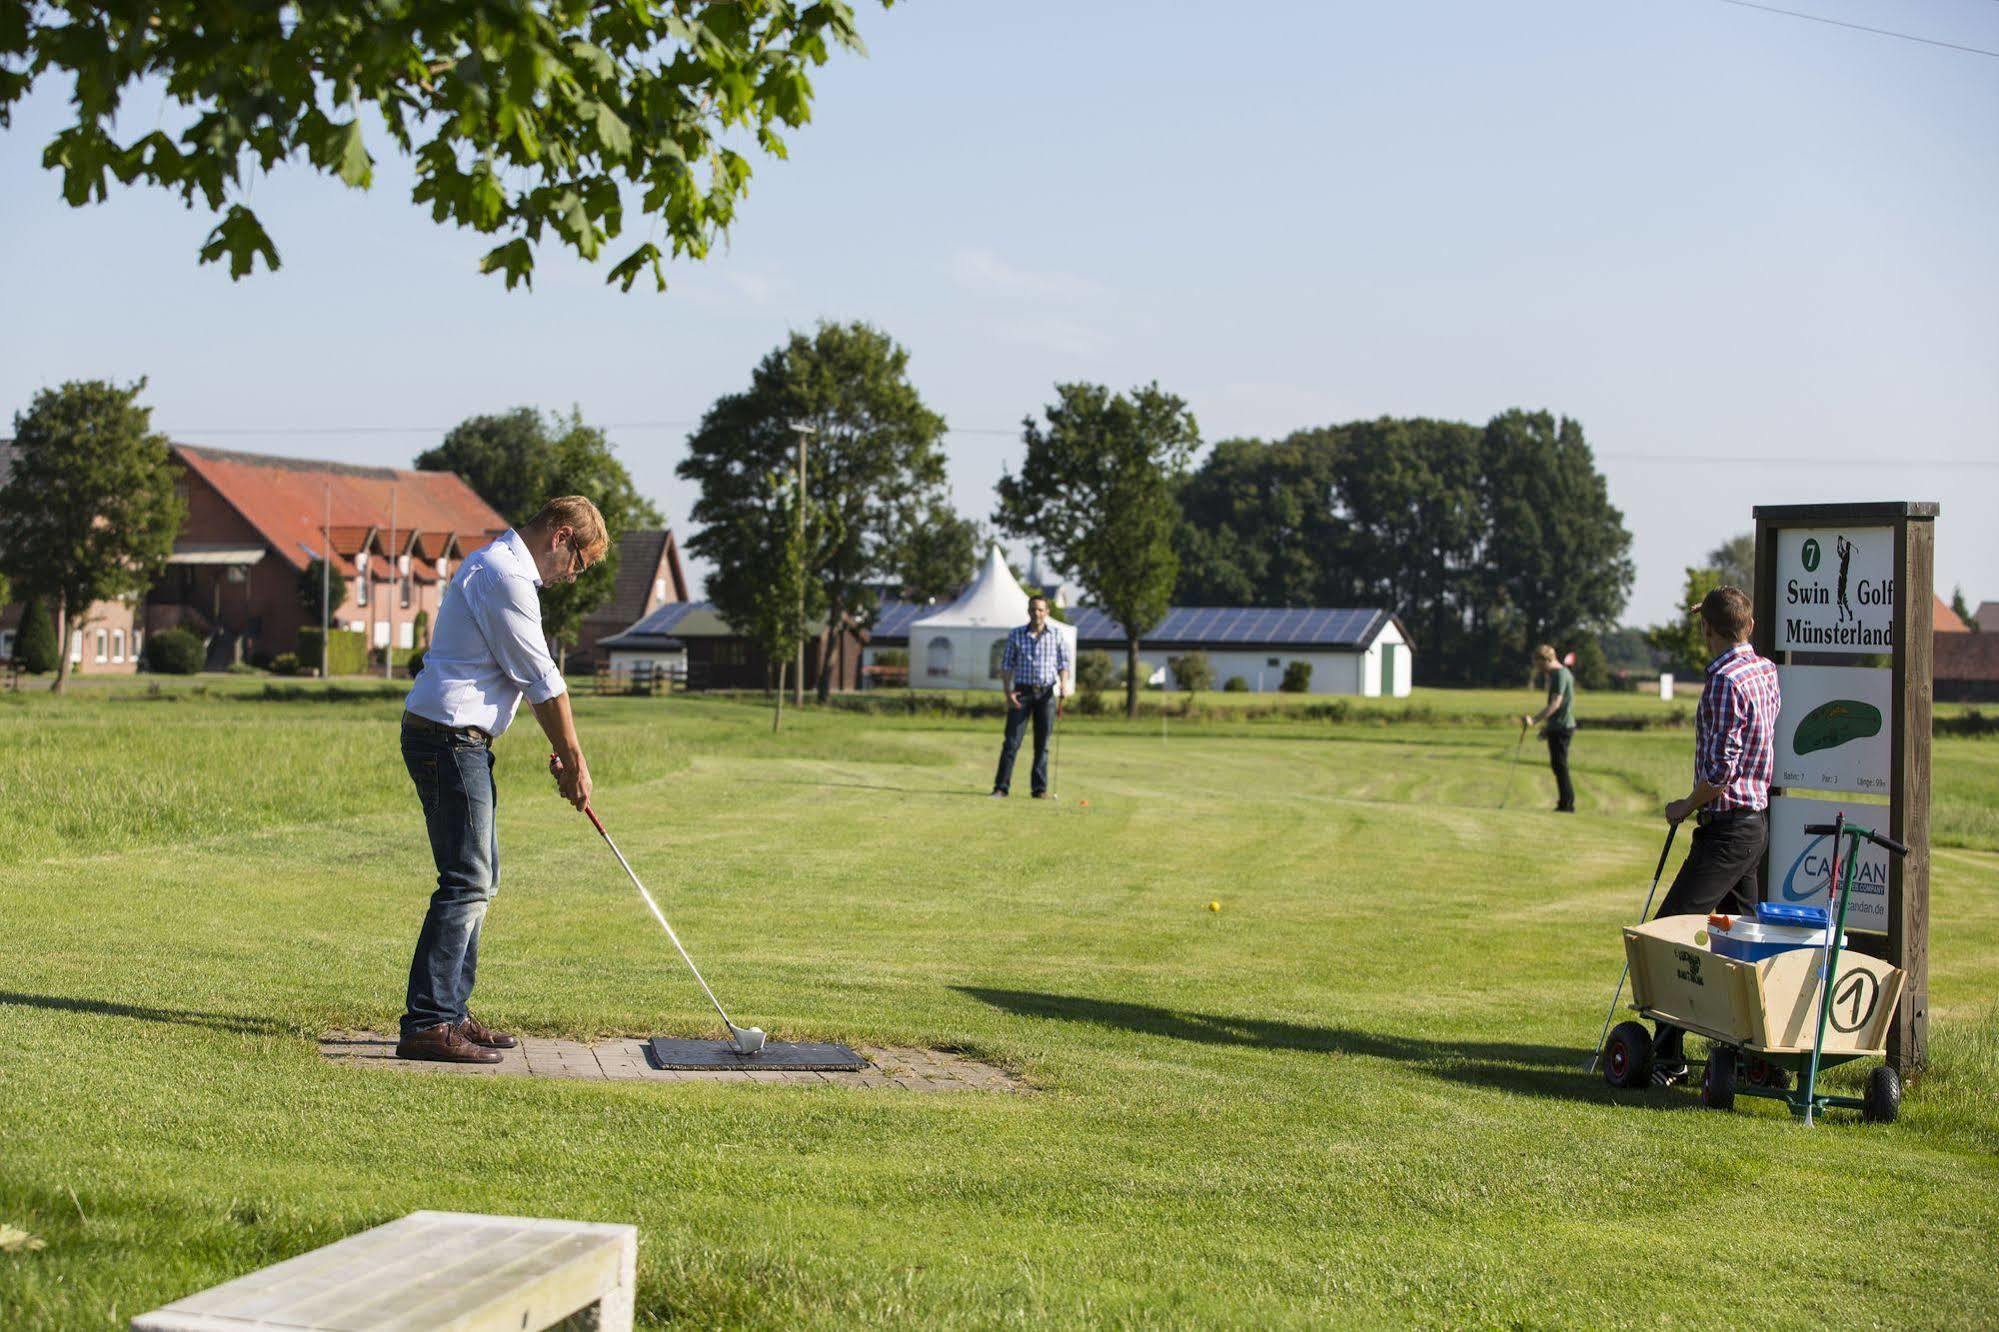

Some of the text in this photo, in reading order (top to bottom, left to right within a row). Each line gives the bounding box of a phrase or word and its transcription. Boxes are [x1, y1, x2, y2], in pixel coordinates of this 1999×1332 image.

[1806, 545, 1816, 567] 7
[1787, 579, 1894, 605] Swin Golf
[1786, 618, 1893, 646] Münsterland
[1837, 977, 1863, 1025] 1
